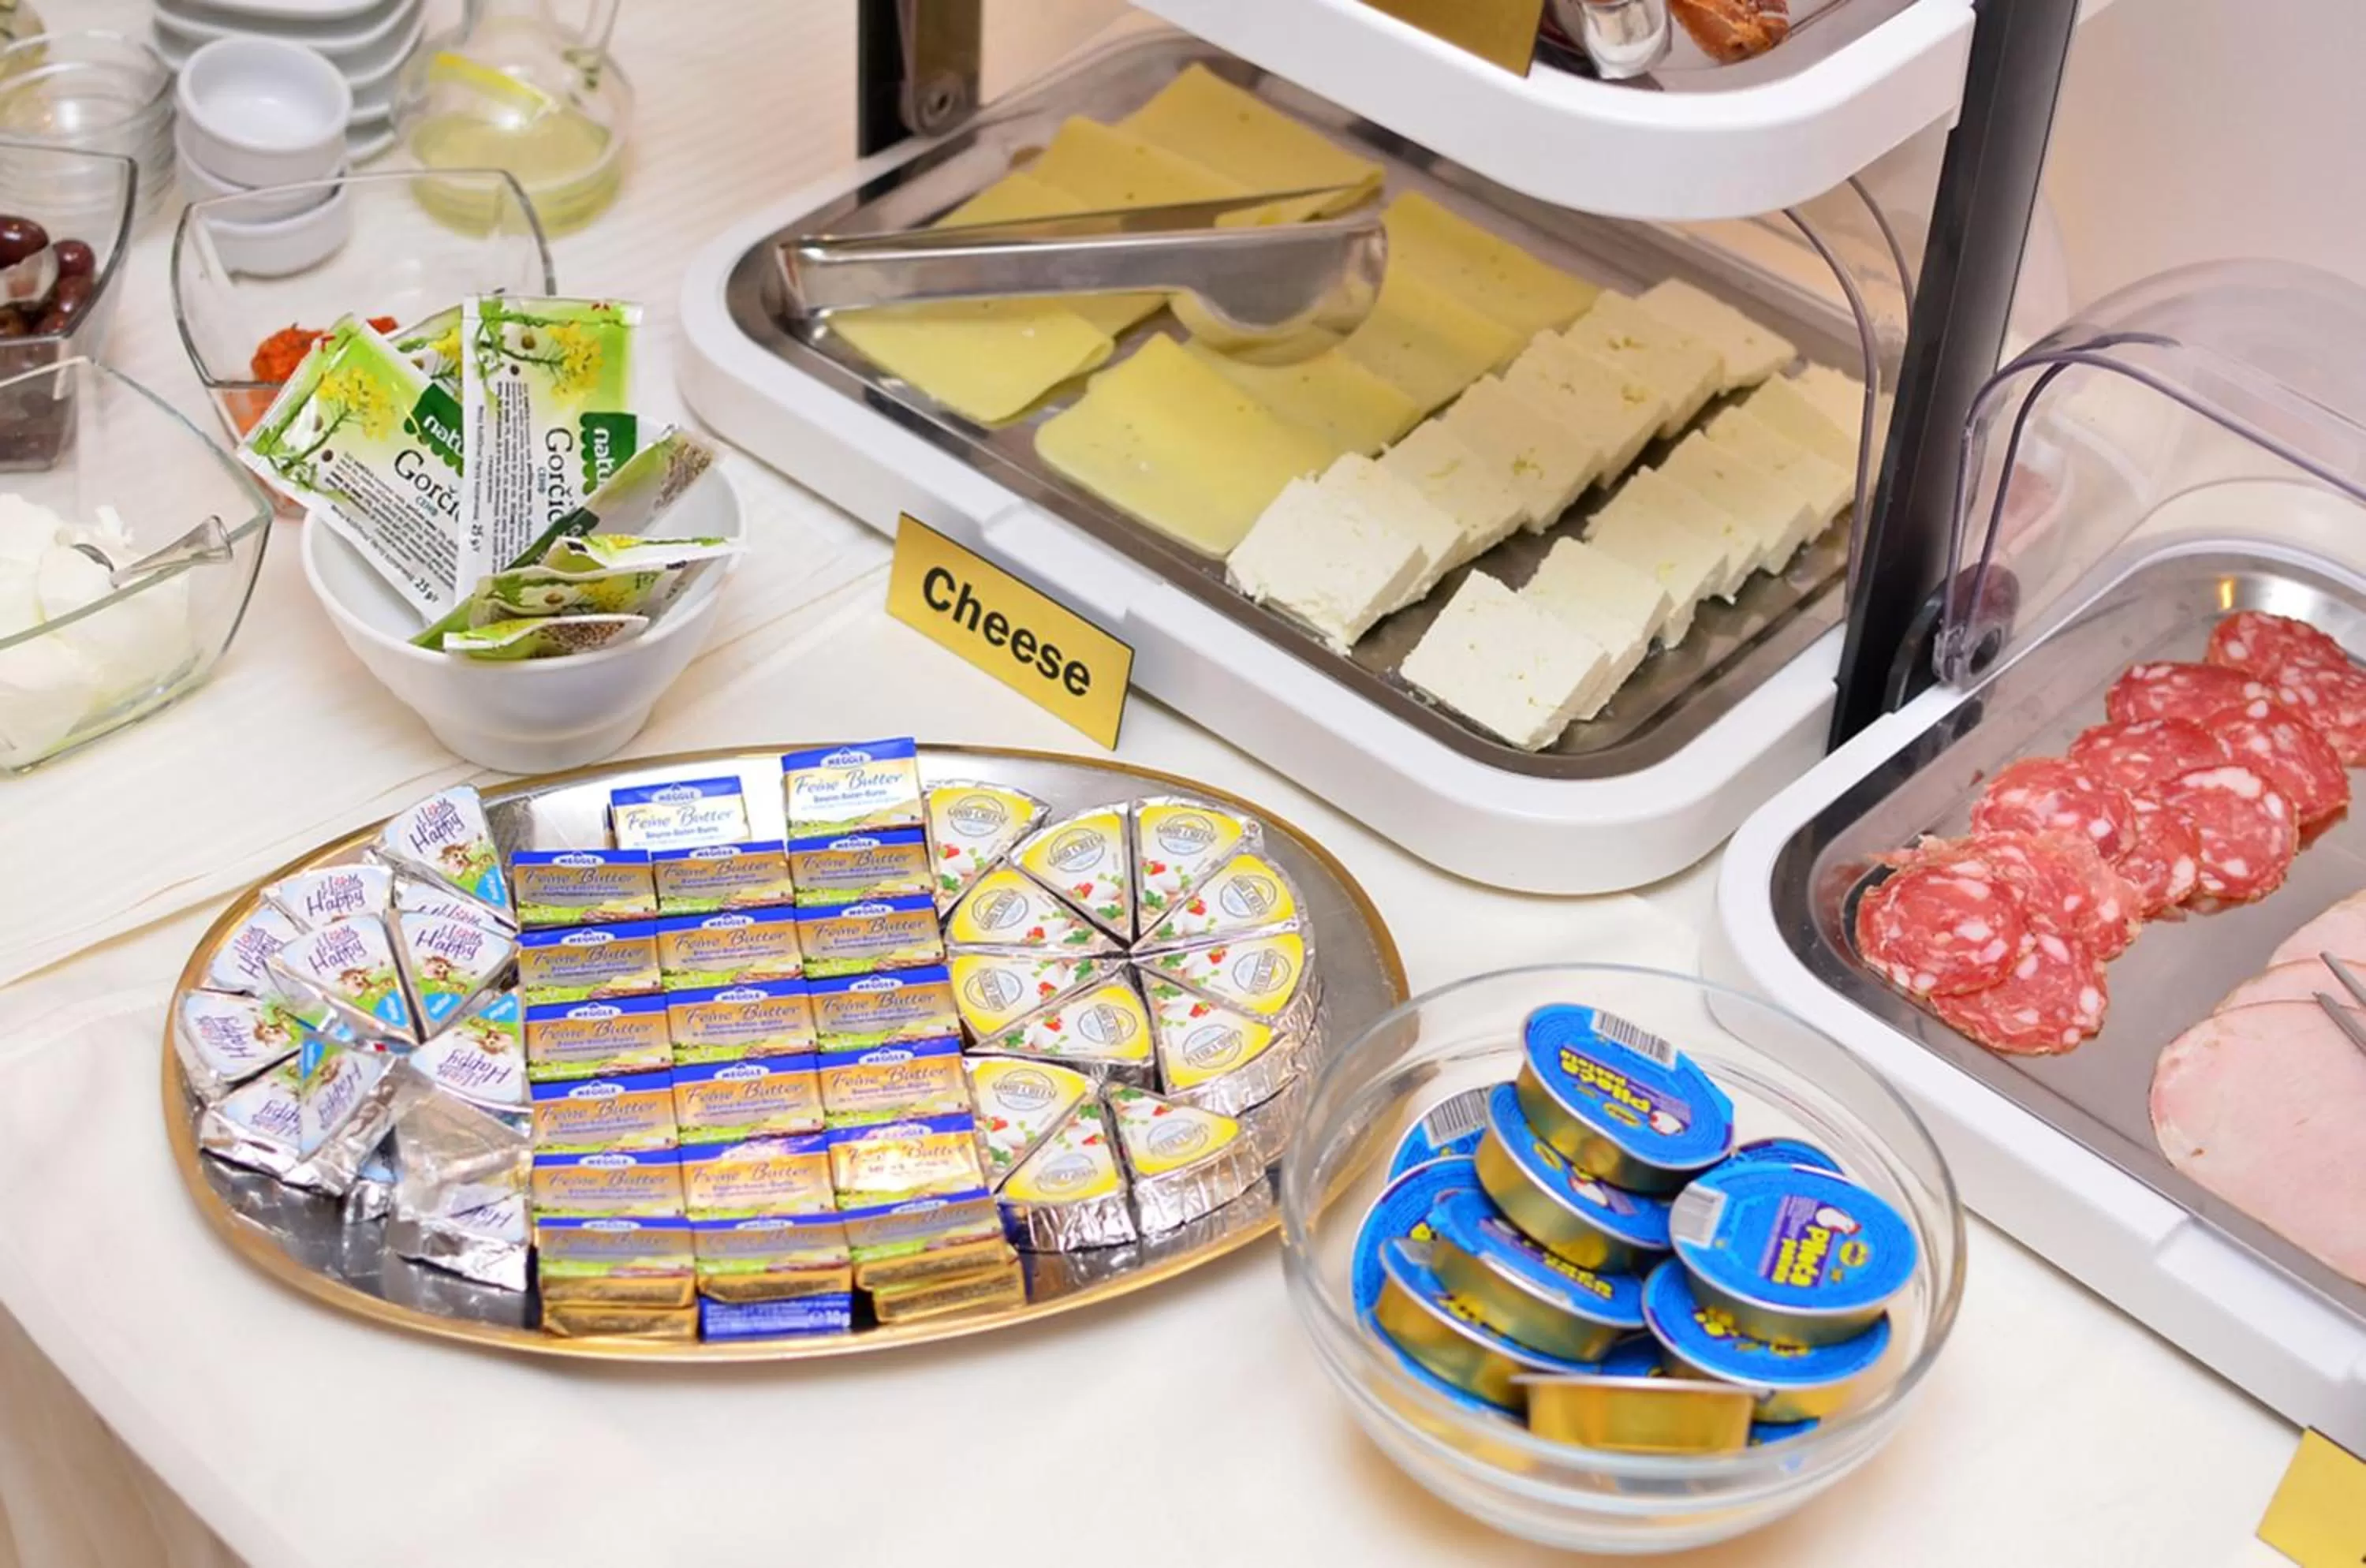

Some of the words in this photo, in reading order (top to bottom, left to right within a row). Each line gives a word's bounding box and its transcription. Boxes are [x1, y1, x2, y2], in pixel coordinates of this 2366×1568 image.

[423, 414, 464, 455] natu
[594, 428, 614, 483] natu
[546, 427, 576, 522] Gorčic
[923, 566, 1092, 697] Cheese
[828, 756, 864, 765] MEGGLE
[793, 773, 840, 795] Feine
[845, 769, 903, 790] Butter
[409, 811, 466, 854] Happy
[625, 809, 671, 831] Feine
[676, 805, 734, 827] Butter
[306, 888, 366, 917] Happy
[415, 928, 479, 961] Happy
[726, 928, 787, 945] Butter
[308, 940, 368, 976] Happy
[739, 1003, 800, 1021] Butter
[446, 1047, 513, 1085] Happy
